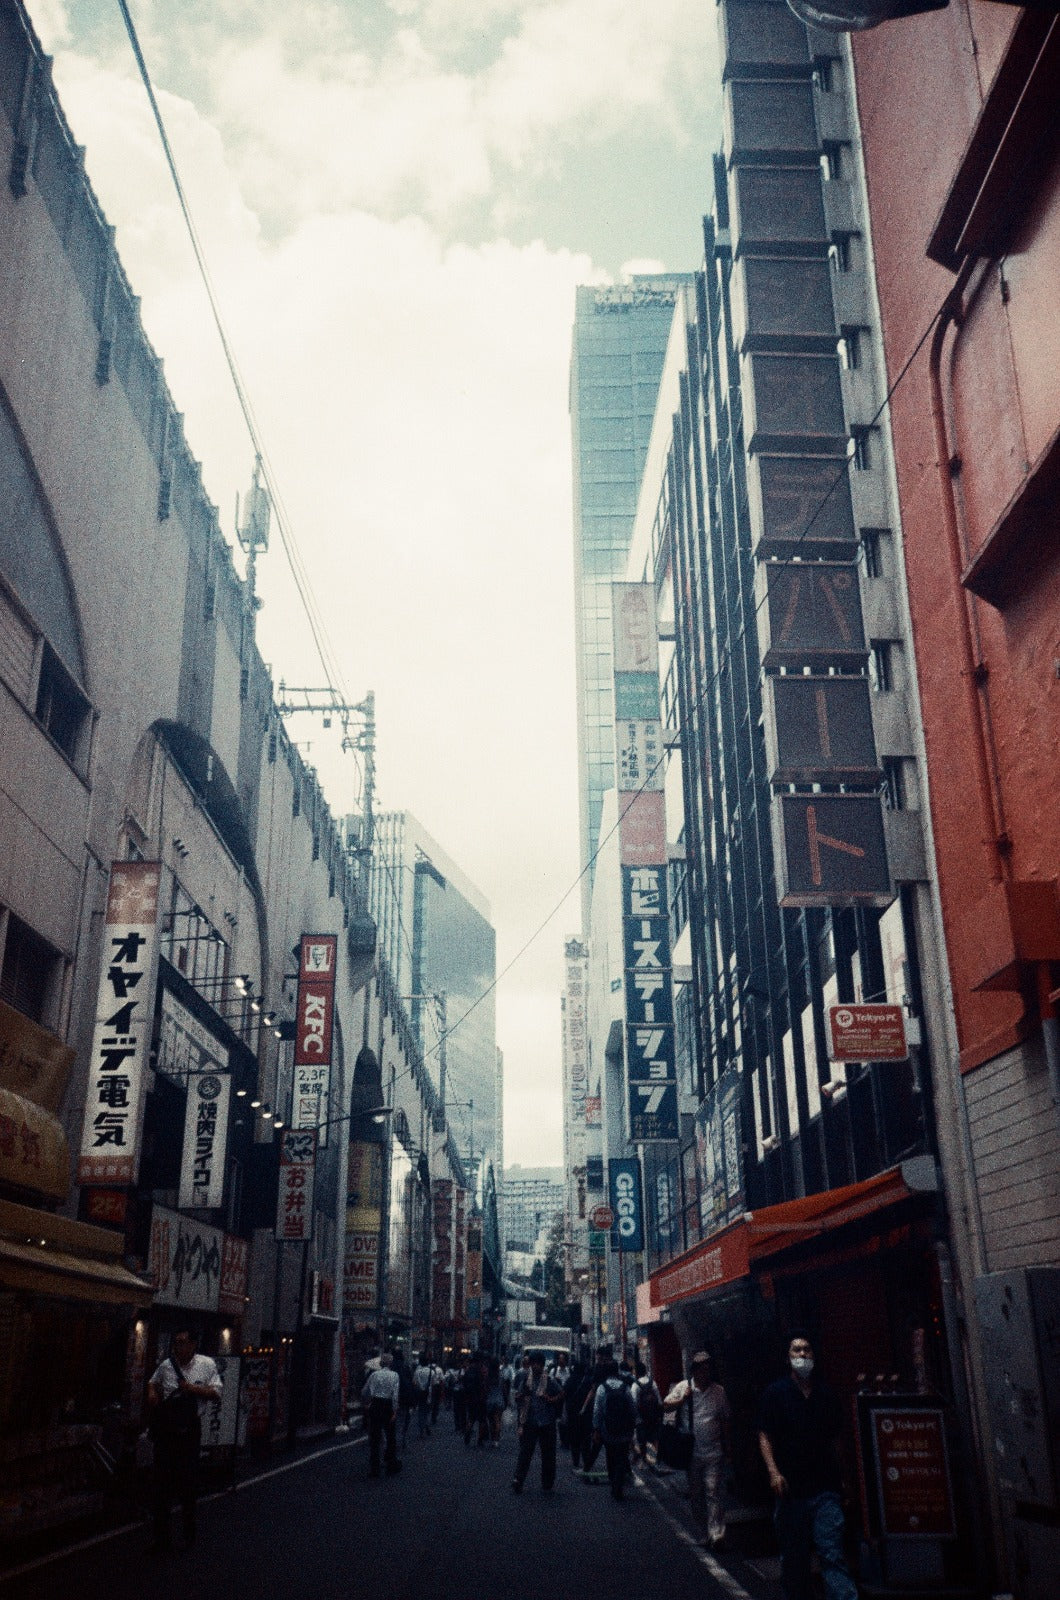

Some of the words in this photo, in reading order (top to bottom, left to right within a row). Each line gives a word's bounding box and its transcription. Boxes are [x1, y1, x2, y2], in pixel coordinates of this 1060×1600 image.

[93, 932, 147, 1148] オヤイデ電気
[303, 992, 326, 1054] KFC
[630, 868, 667, 1113] ホビーステーション
[284, 1167, 306, 1238] お弁当
